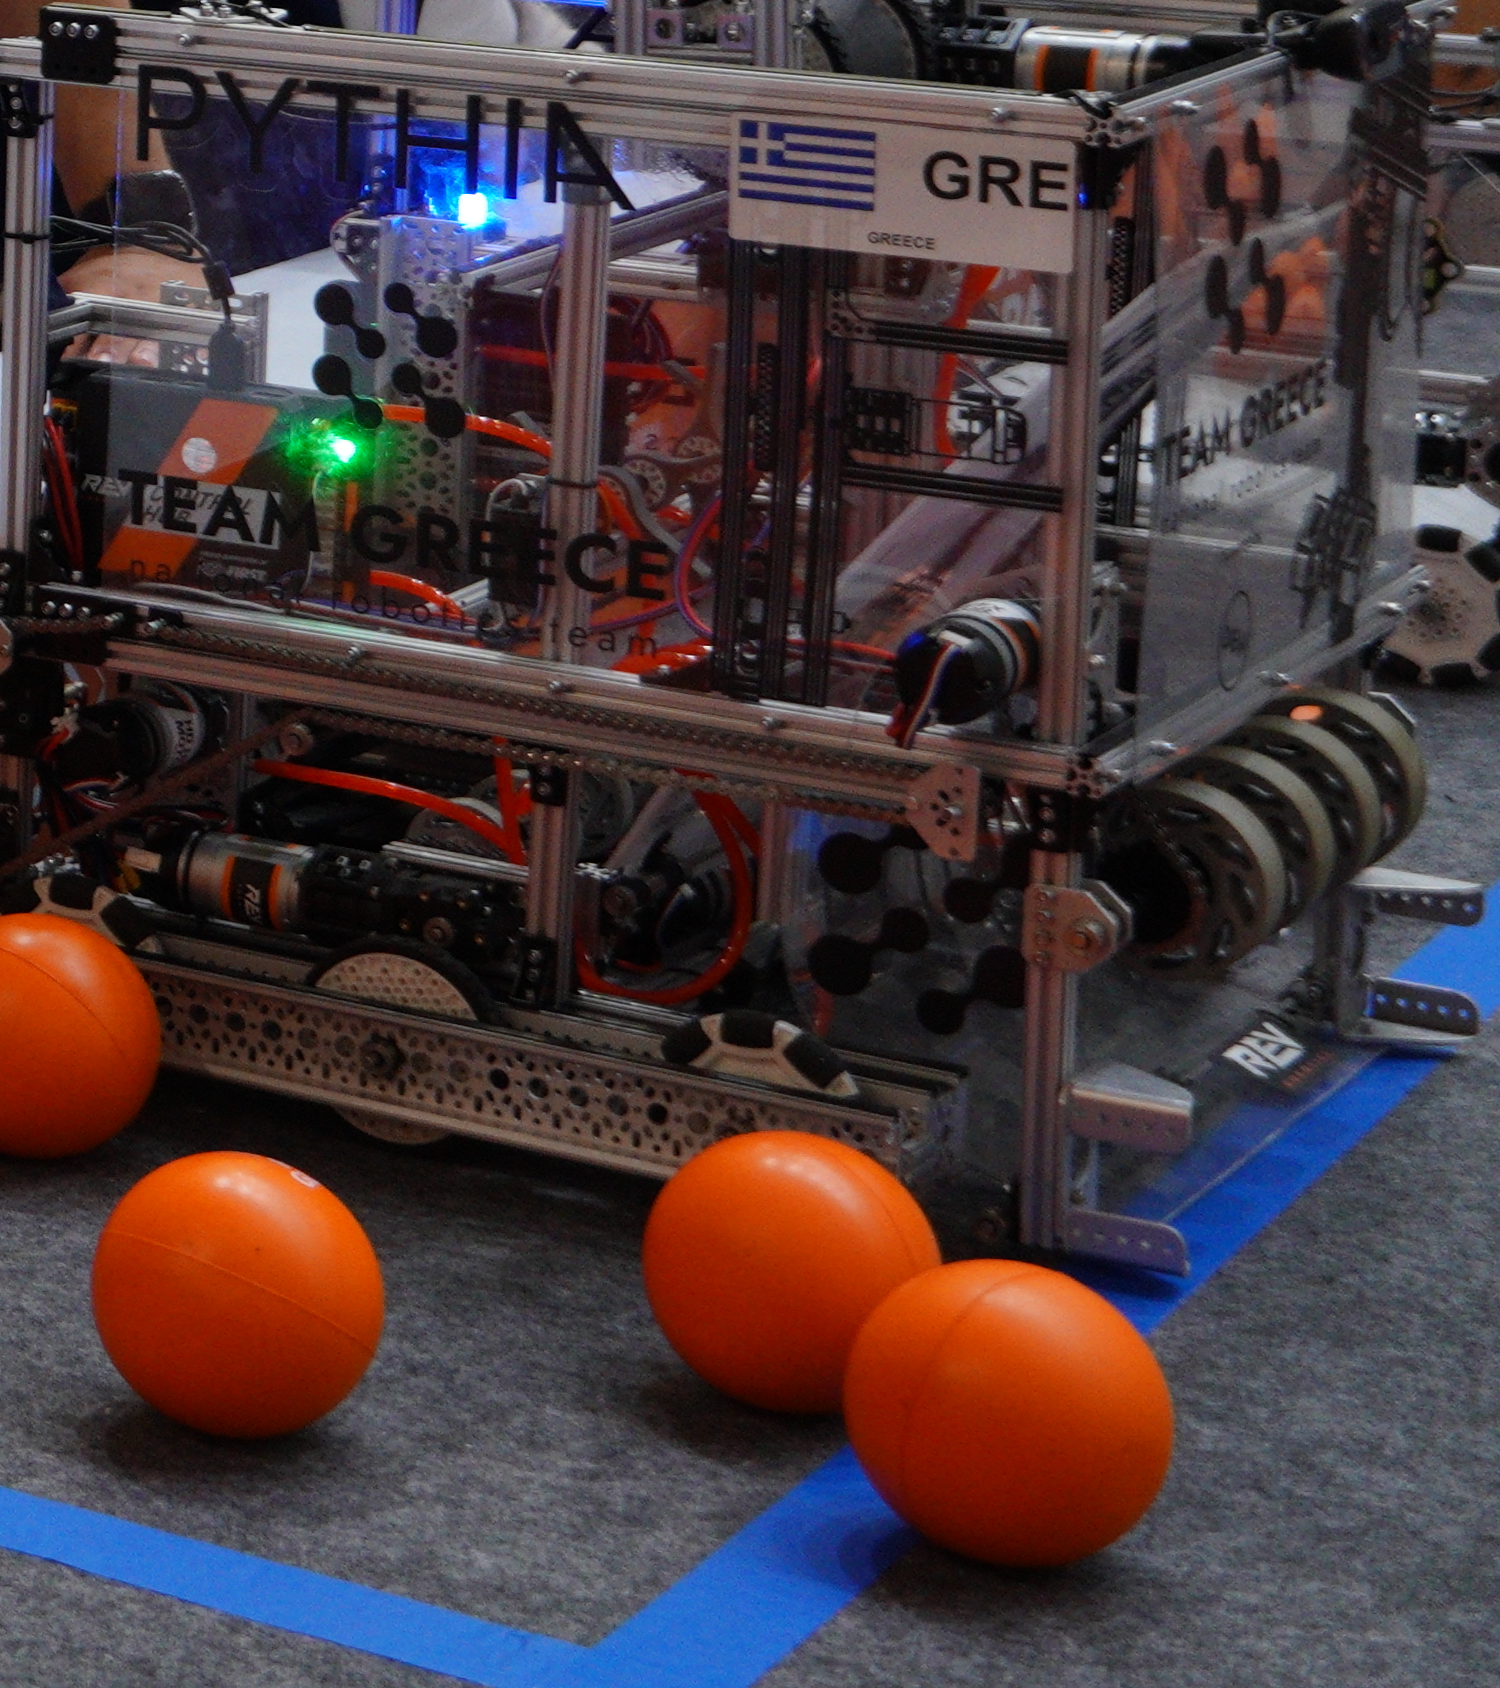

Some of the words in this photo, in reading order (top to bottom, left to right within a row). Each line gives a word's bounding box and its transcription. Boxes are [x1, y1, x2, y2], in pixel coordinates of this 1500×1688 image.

[136, 64, 637, 211] PYTHIA
[923, 150, 1069, 212] GRE
[867, 230, 936, 251] GREECE
[118, 468, 320, 552] TEAM
[351, 504, 675, 602] GREECE
[548, 622, 659, 658] team
[1221, 1021, 1304, 1079] REV
